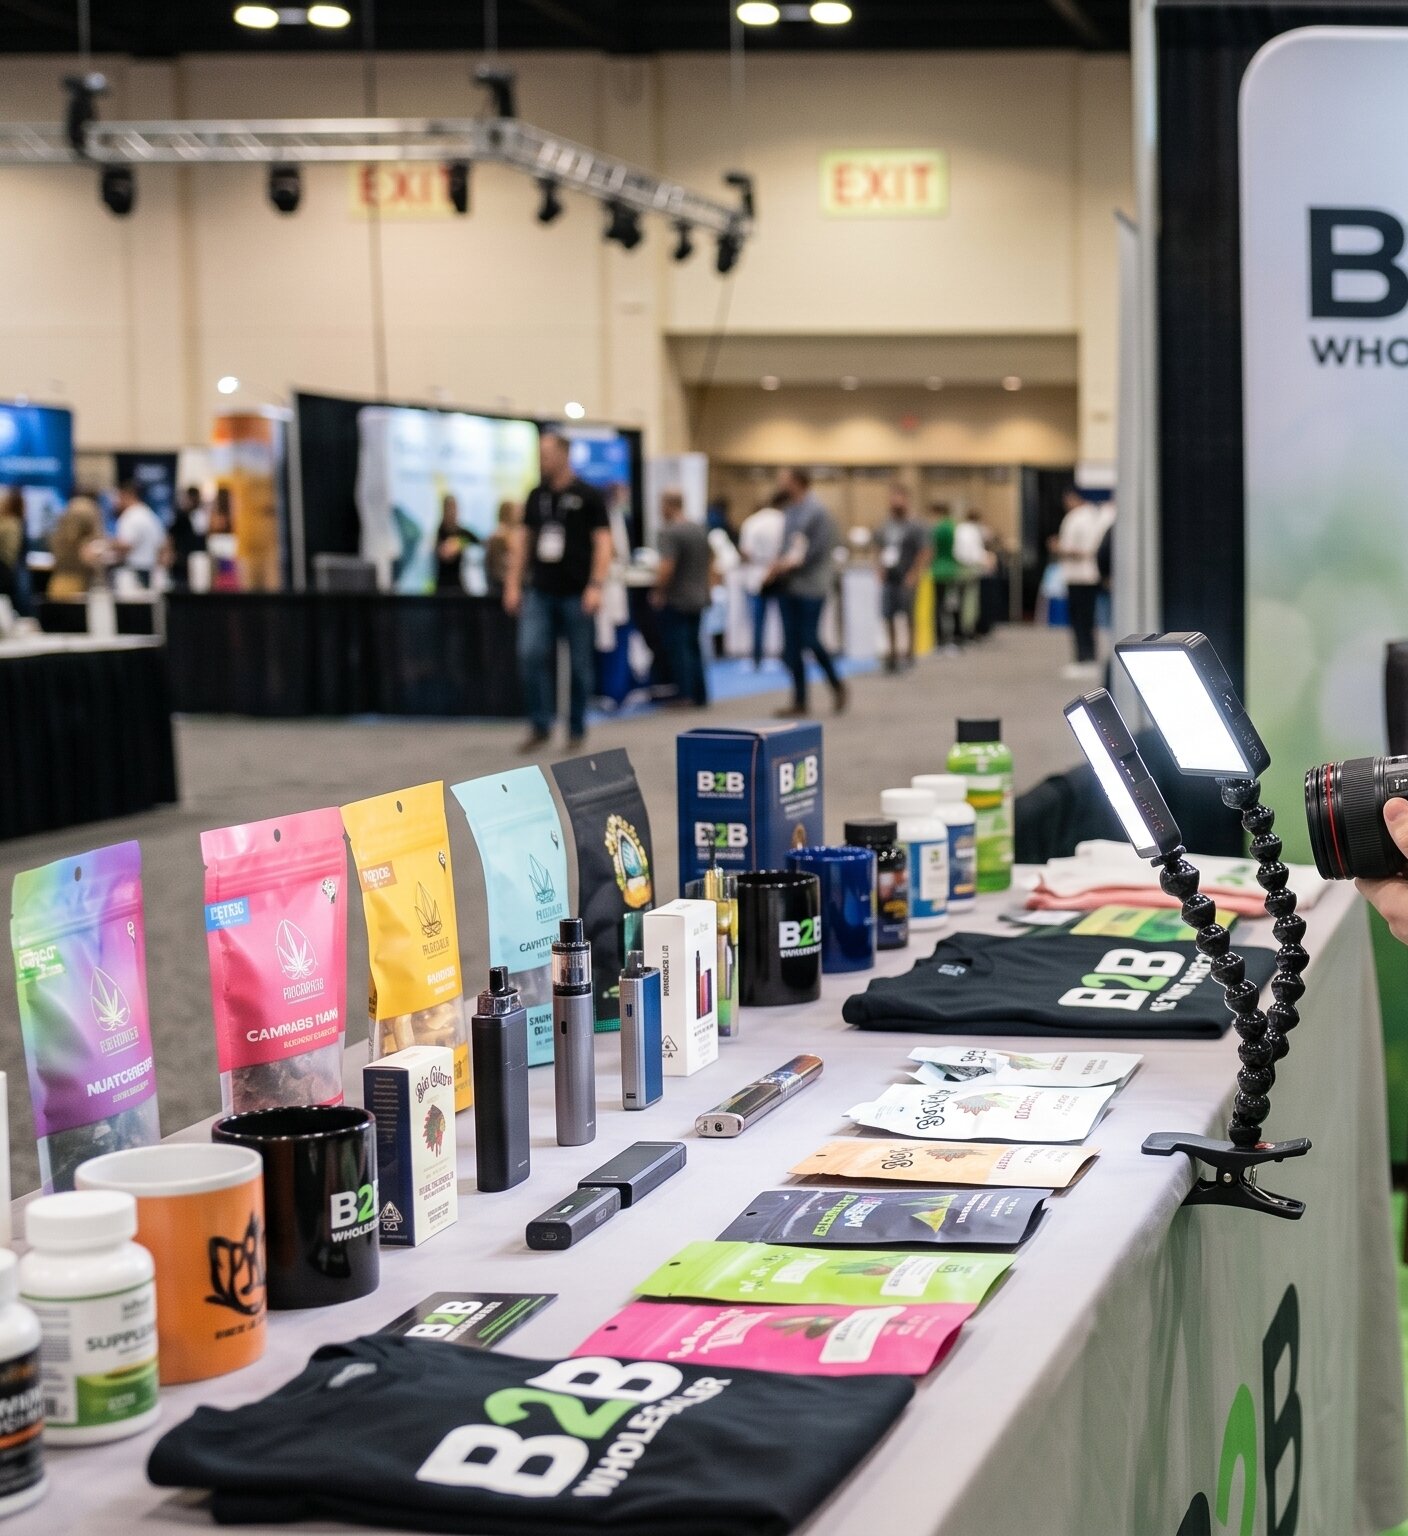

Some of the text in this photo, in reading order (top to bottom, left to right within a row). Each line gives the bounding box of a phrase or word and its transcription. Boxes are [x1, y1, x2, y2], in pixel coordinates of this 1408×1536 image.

[834, 163, 933, 206] EXIT
[697, 770, 745, 792] B2B
[780, 755, 818, 795] B2B
[1057, 948, 1186, 1012] B2B
[403, 1301, 484, 1338] B2B
[415, 1355, 684, 1498] B2B
